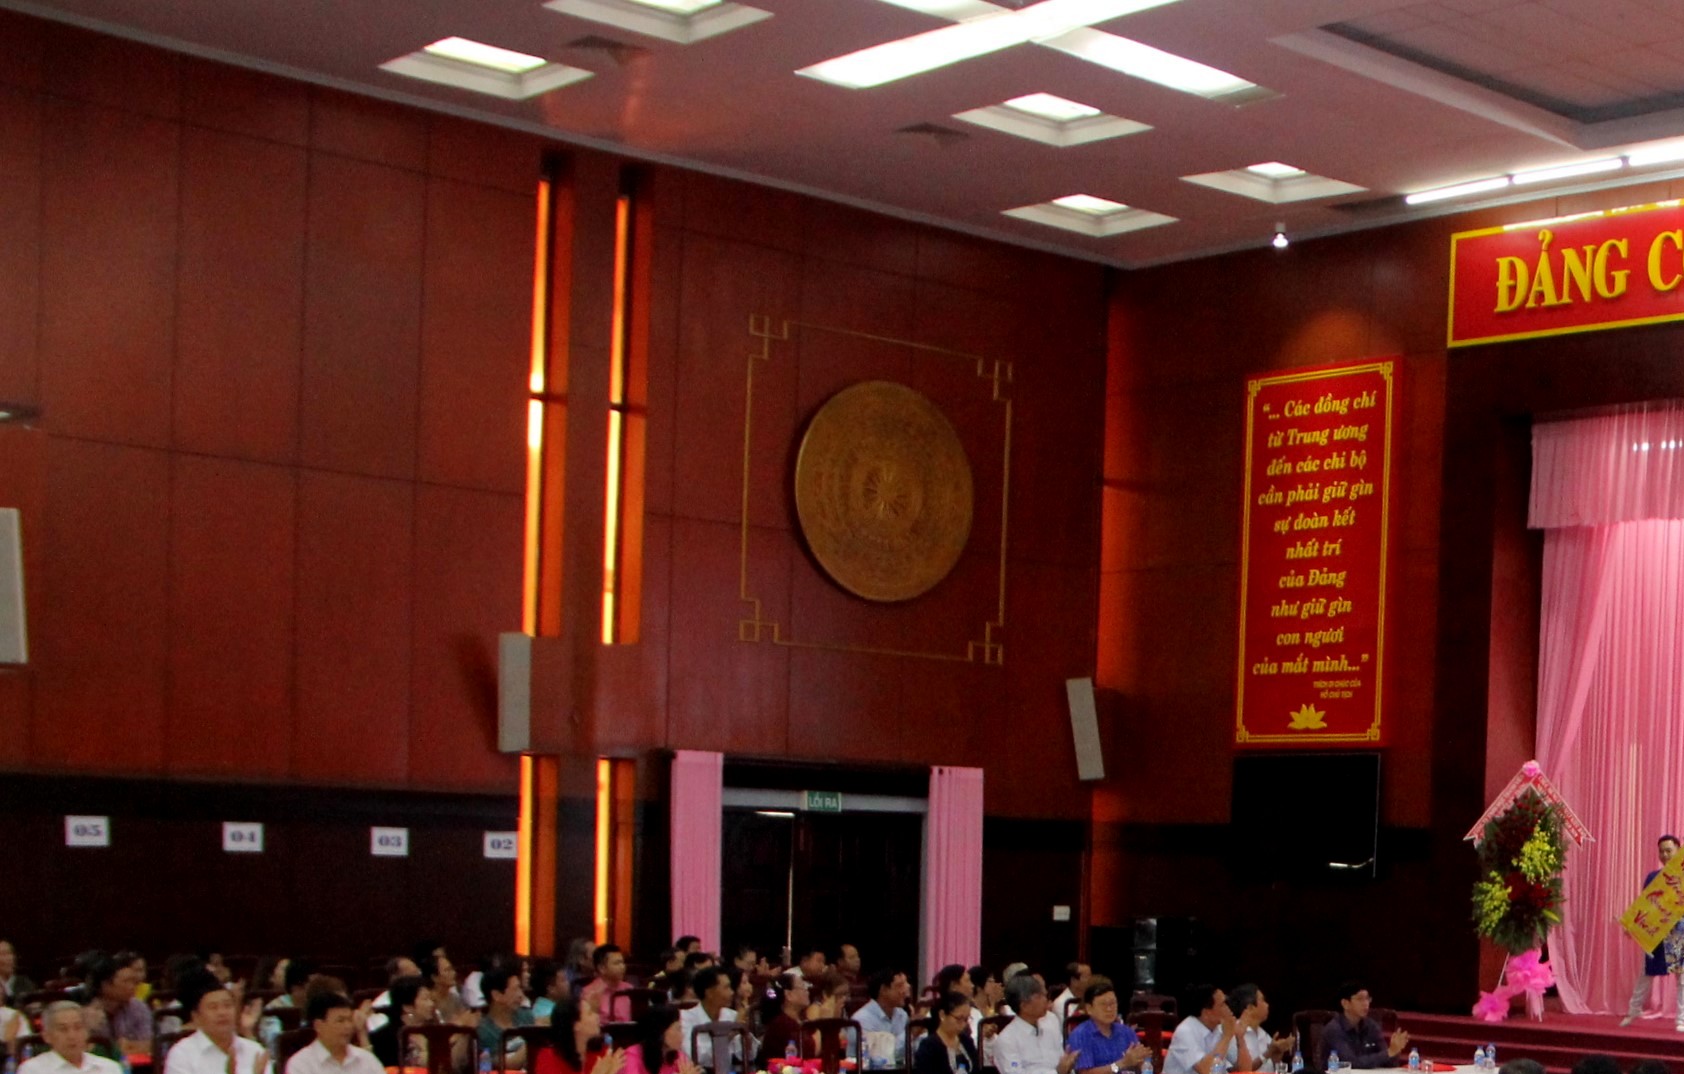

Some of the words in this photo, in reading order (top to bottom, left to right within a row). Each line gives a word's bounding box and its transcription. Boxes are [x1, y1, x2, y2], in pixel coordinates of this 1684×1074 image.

[1494, 229, 1631, 313] ĐẢNG
[1284, 400, 1311, 418] Các
[1314, 393, 1350, 415] đồng
[1353, 390, 1377, 409] chí
[1268, 430, 1284, 448] từ
[1287, 428, 1330, 446] Trung
[1333, 424, 1369, 441] ương
[1266, 455, 1293, 477] đến
[1296, 455, 1320, 473] các
[1323, 451, 1346, 470] chi
[1350, 449, 1368, 470] bộ
[1285, 482, 1320, 507] phải
[1350, 479, 1374, 501] gìn
[1274, 516, 1292, 536] sự
[1293, 511, 1329, 531] đoàn
[1332, 506, 1356, 527] kết
[1286, 537, 1319, 560] nhất
[1322, 538, 1343, 557] trí
[1278, 569, 1305, 589] của
[1307, 567, 1347, 588] Đảng
[1270, 599, 1300, 618] như
[1327, 596, 1353, 618] gìn
[1276, 631, 1301, 646] con
[1252, 656, 1278, 675] của
[1281, 652, 1309, 674] mắt
[378, 834, 402, 848] 03
[489, 838, 513, 850] 02
